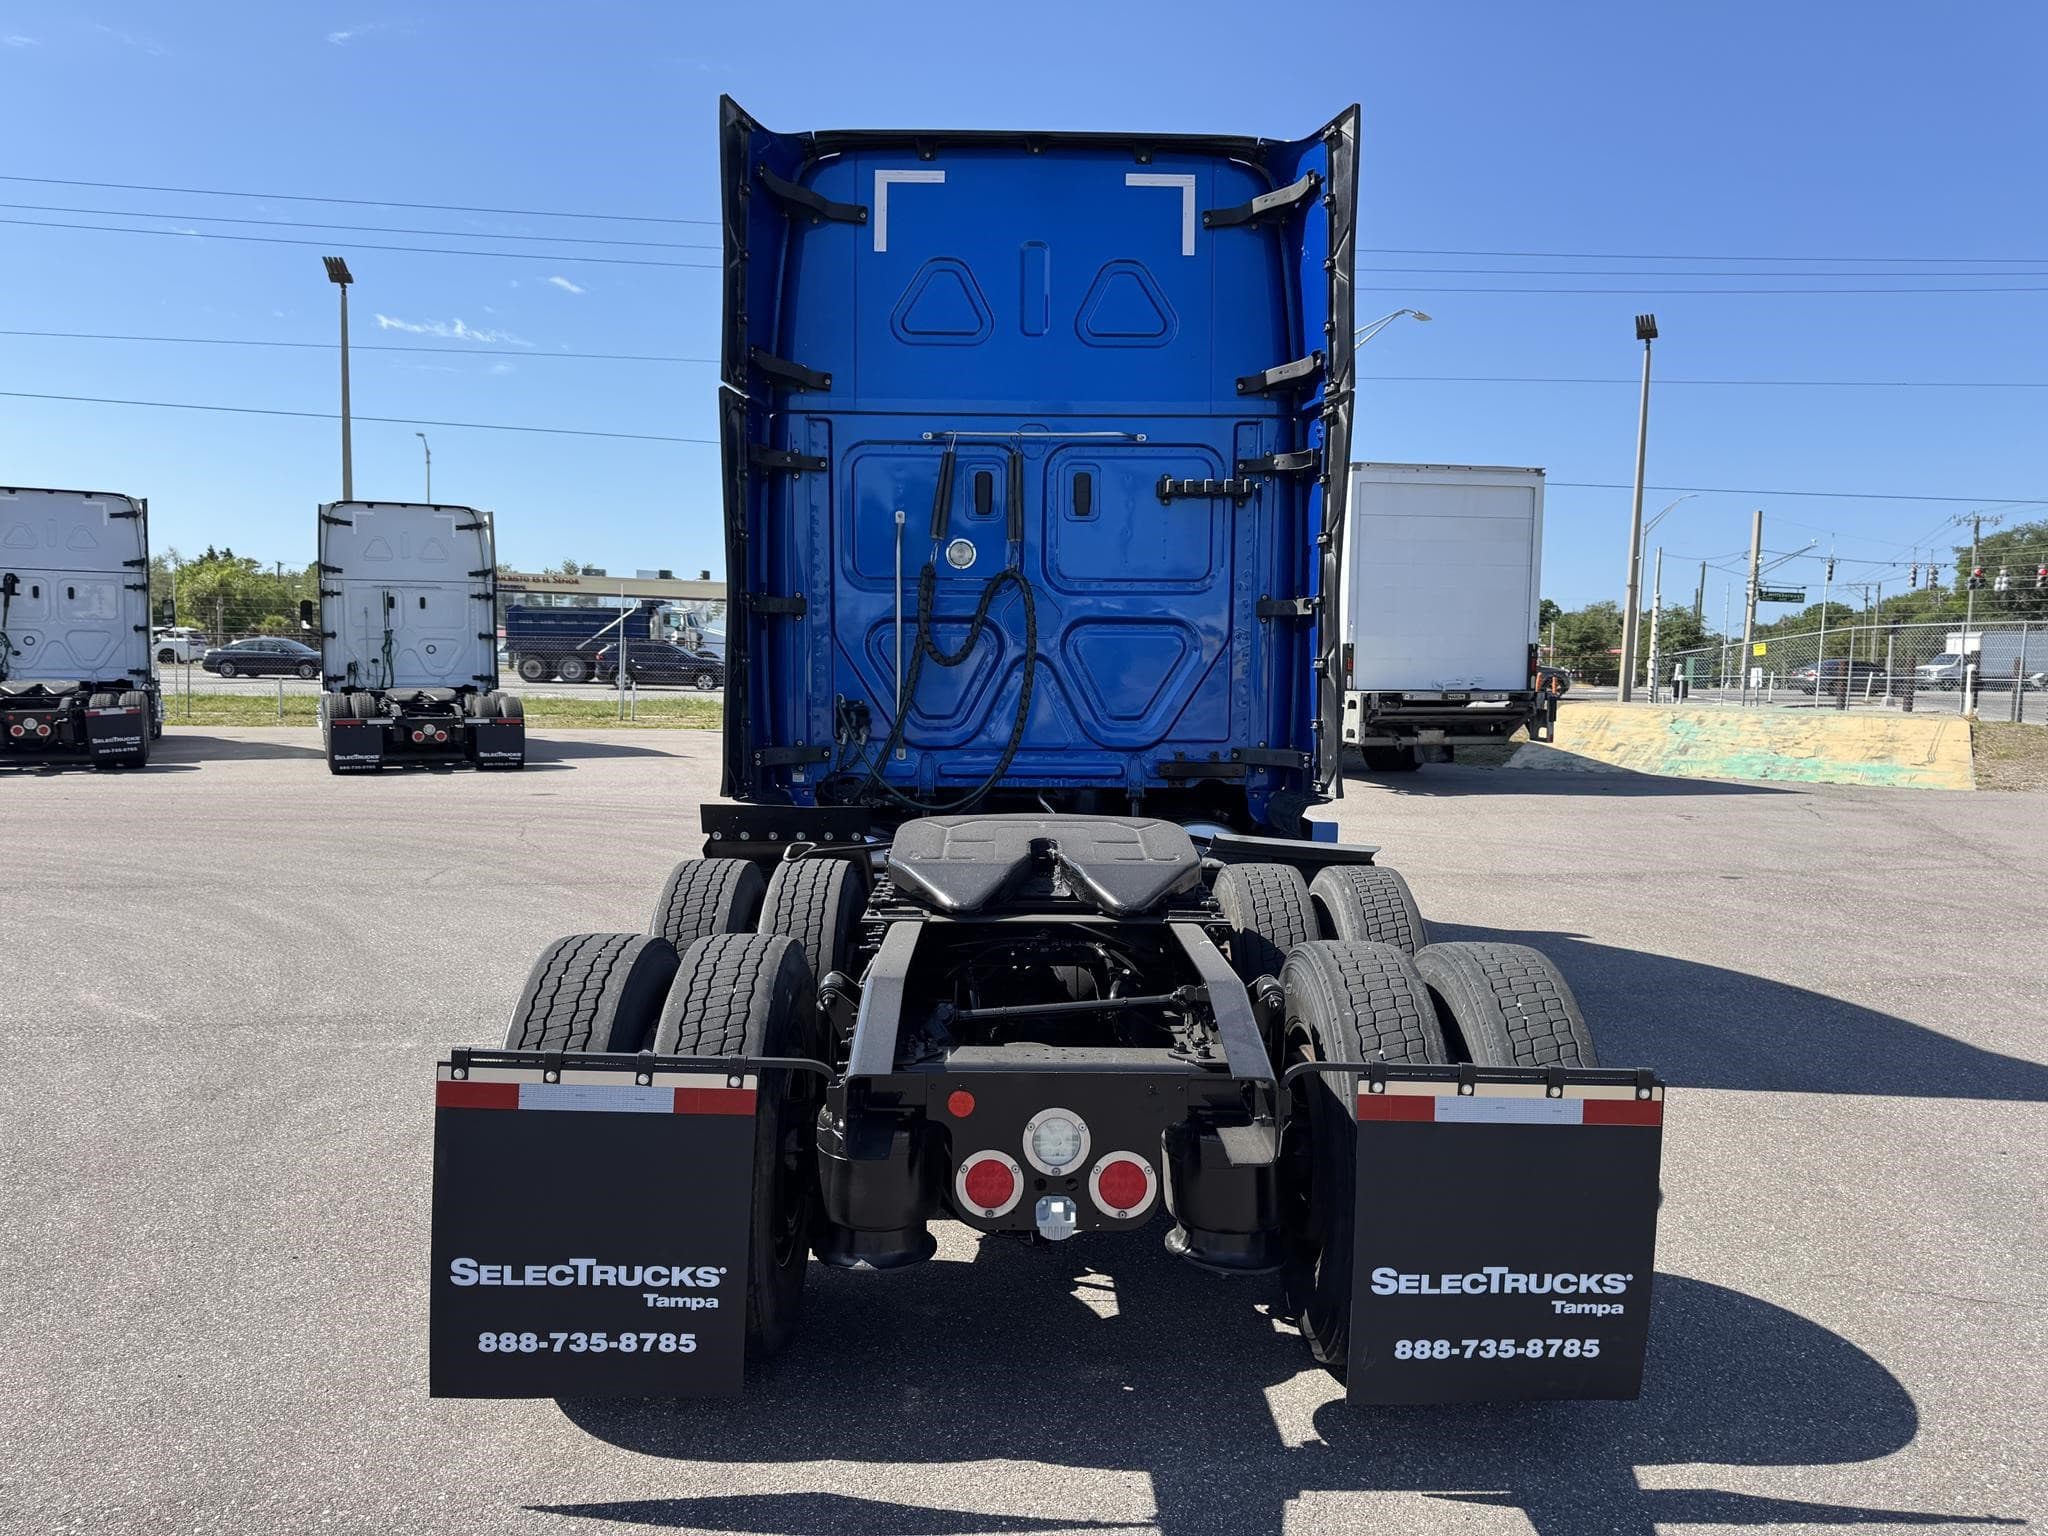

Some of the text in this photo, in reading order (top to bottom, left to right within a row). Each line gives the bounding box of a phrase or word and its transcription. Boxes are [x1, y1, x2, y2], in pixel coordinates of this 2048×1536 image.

[496, 575, 530, 583] UCRISTO
[449, 1257, 721, 1288] SELECTRUCKS
[1370, 1266, 1627, 1296] SELECTRUCKS
[642, 1293, 719, 1311] Tampa
[1550, 1300, 1625, 1318] Tampa
[477, 1331, 697, 1353] 888-735-8785
[1393, 1338, 1600, 1360] 888-735-8785
